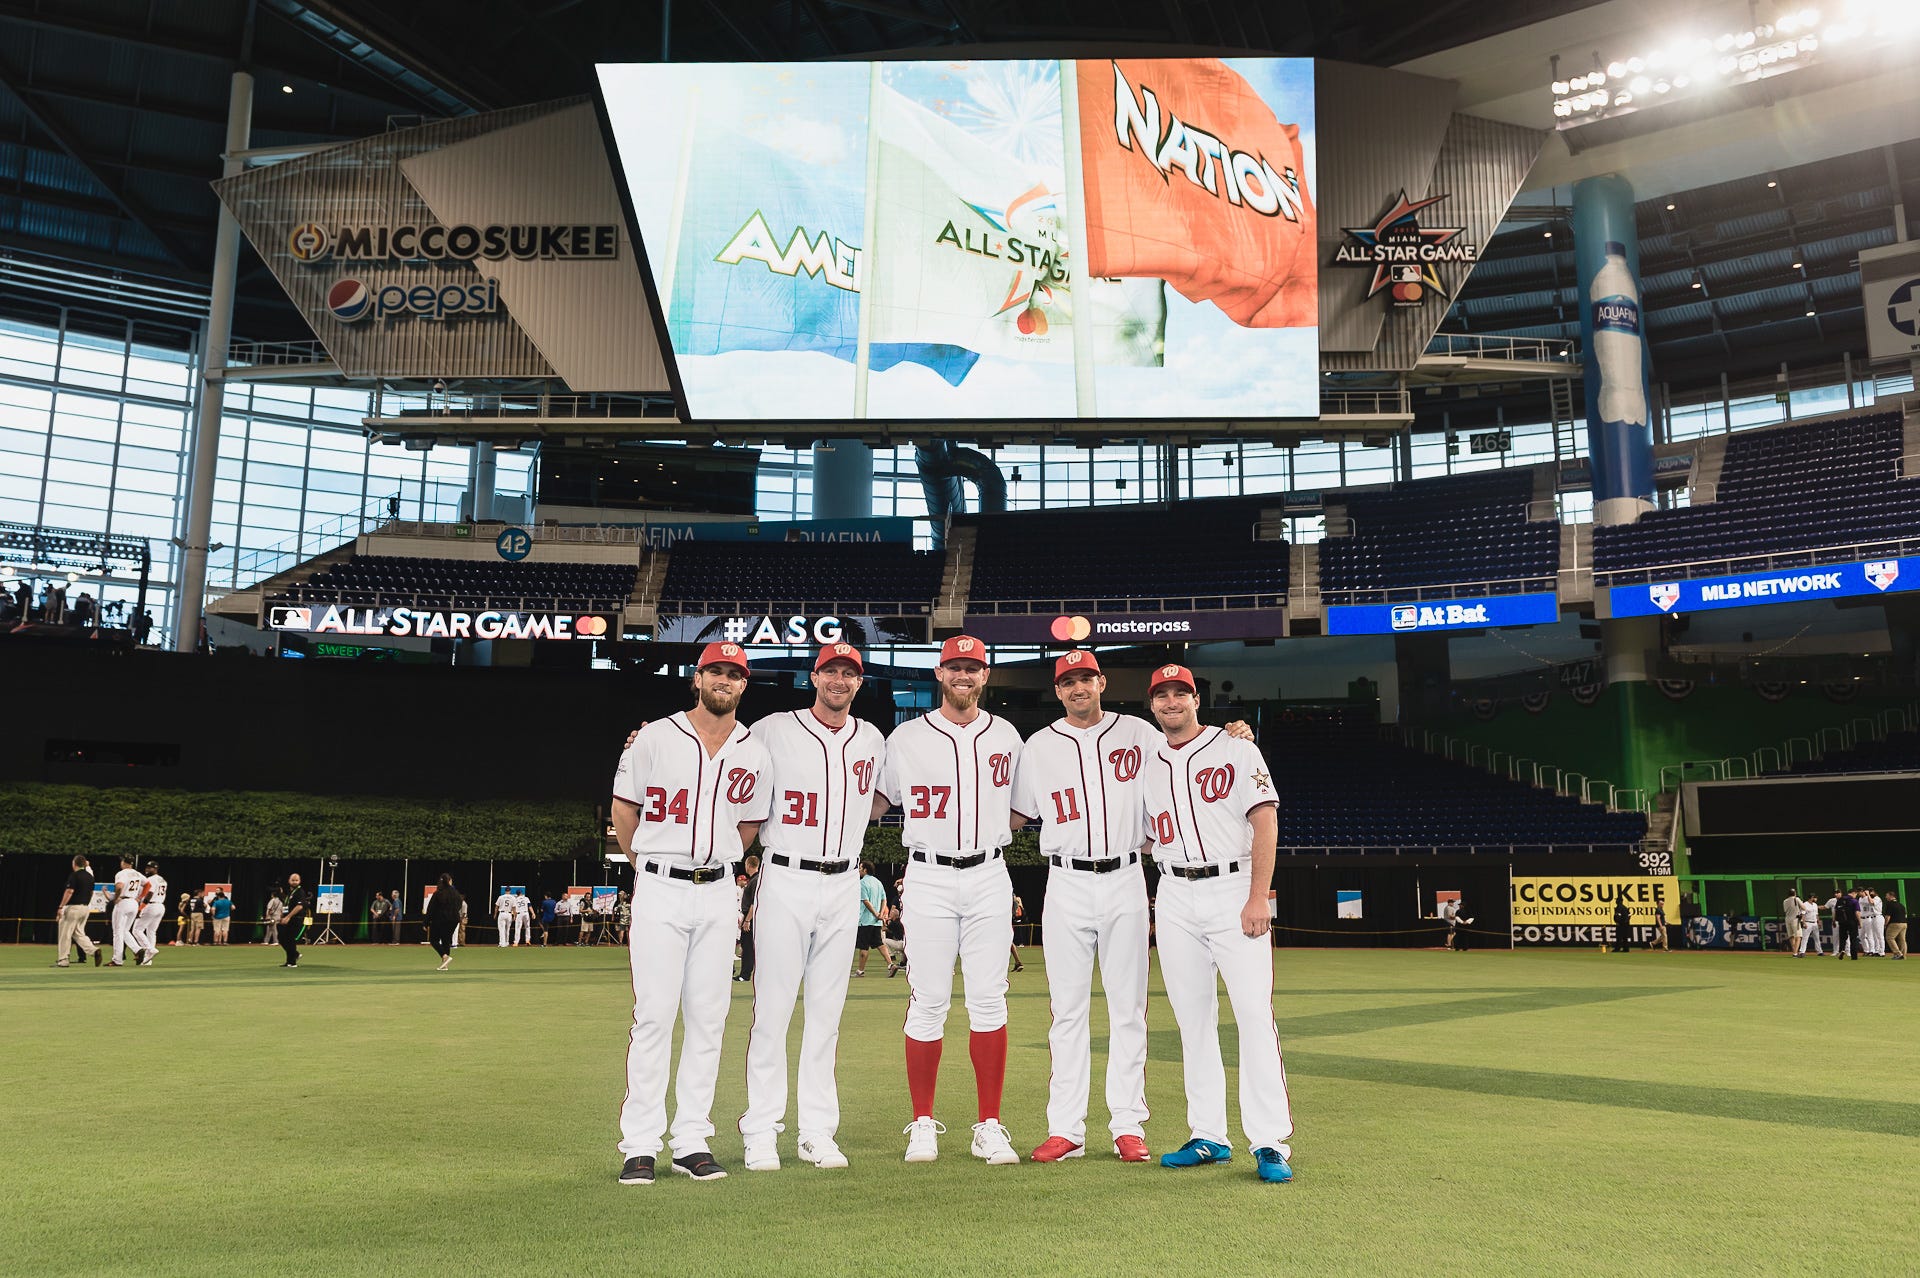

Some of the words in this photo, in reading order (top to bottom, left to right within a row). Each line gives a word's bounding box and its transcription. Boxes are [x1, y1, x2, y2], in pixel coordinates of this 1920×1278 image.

[337, 225, 616, 260] MICCOSUKEE
[936, 219, 999, 261] ALL
[1006, 237, 1052, 270] STA
[1336, 245, 1371, 261] ALL
[1374, 244, 1417, 261] STAR
[1420, 244, 1476, 261] GAME
[376, 277, 499, 321] pepsi
[1471, 433, 1511, 453] 465
[501, 535, 526, 553] 42
[1702, 583, 1741, 601] MLB
[1743, 573, 1841, 598] NETWORK
[315, 604, 384, 635] ALL
[389, 607, 471, 638] STAR
[474, 611, 572, 640] GAME
[724, 615, 843, 645] #ASG
[1418, 606, 1445, 626] At
[852, 756, 875, 796] W
[989, 752, 1012, 787] W
[1108, 745, 1143, 783] W
[726, 767, 760, 804] W
[1195, 763, 1235, 803] W
[645, 786, 689, 825] 34
[781, 790, 819, 827] 31
[910, 785, 951, 819] 37
[1051, 787, 1081, 825] 11
[1639, 852, 1671, 867] 392
[1648, 867, 1671, 876] 119M
[128, 879, 140, 892] 27
[1512, 883, 1665, 903] ICCOSUKEE
[1523, 906, 1539, 916] OF
[1541, 906, 1592, 916] INDIANS
[1594, 906, 1611, 916] OF
